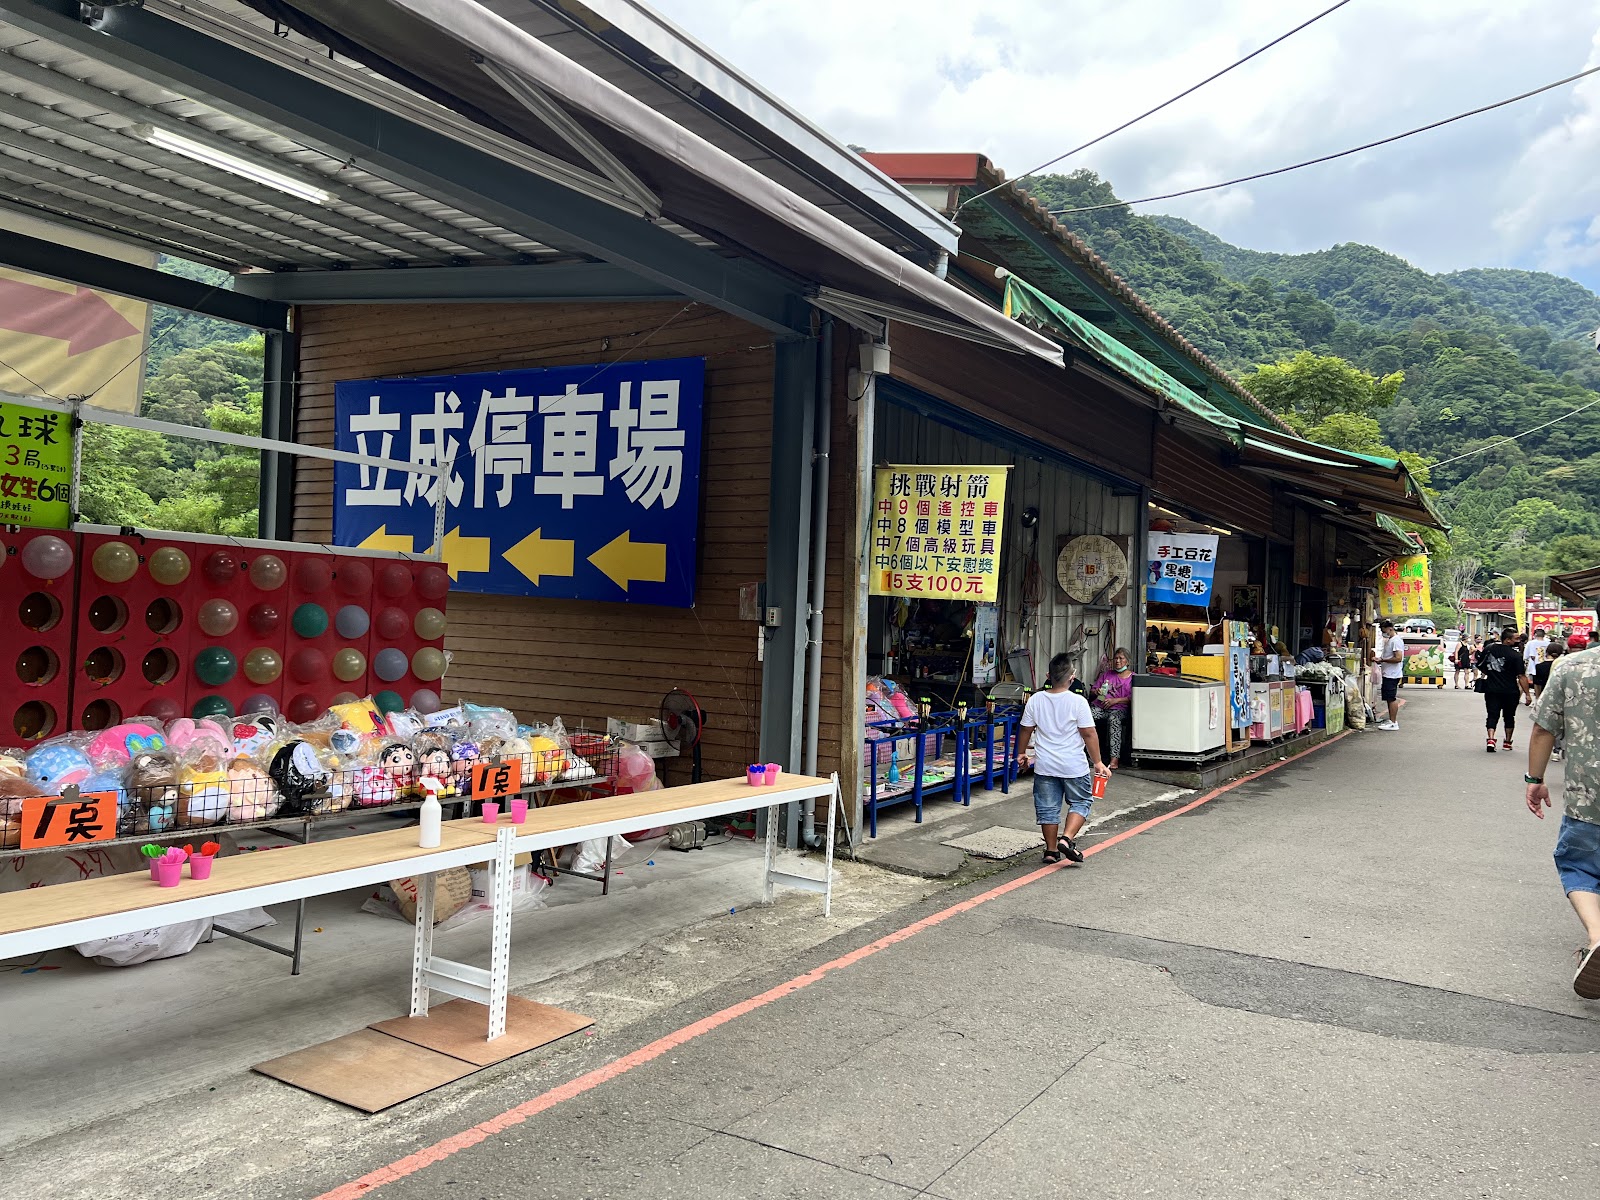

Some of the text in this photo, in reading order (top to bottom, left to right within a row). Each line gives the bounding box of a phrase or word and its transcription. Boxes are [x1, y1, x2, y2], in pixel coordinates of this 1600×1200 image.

[346, 380, 686, 510] 立成停車場
[889, 472, 990, 499] 挑戰射箭
[877, 498, 999, 518] 中9個遙控車
[877, 516, 997, 537] 中8個模型車
[876, 535, 995, 556] 中7個高級玩具
[1157, 545, 1213, 562] 手工豆花
[1164, 563, 1192, 579] 黑糖
[885, 572, 984, 594] 15支100元
[1174, 578, 1205, 594] 刨冰
